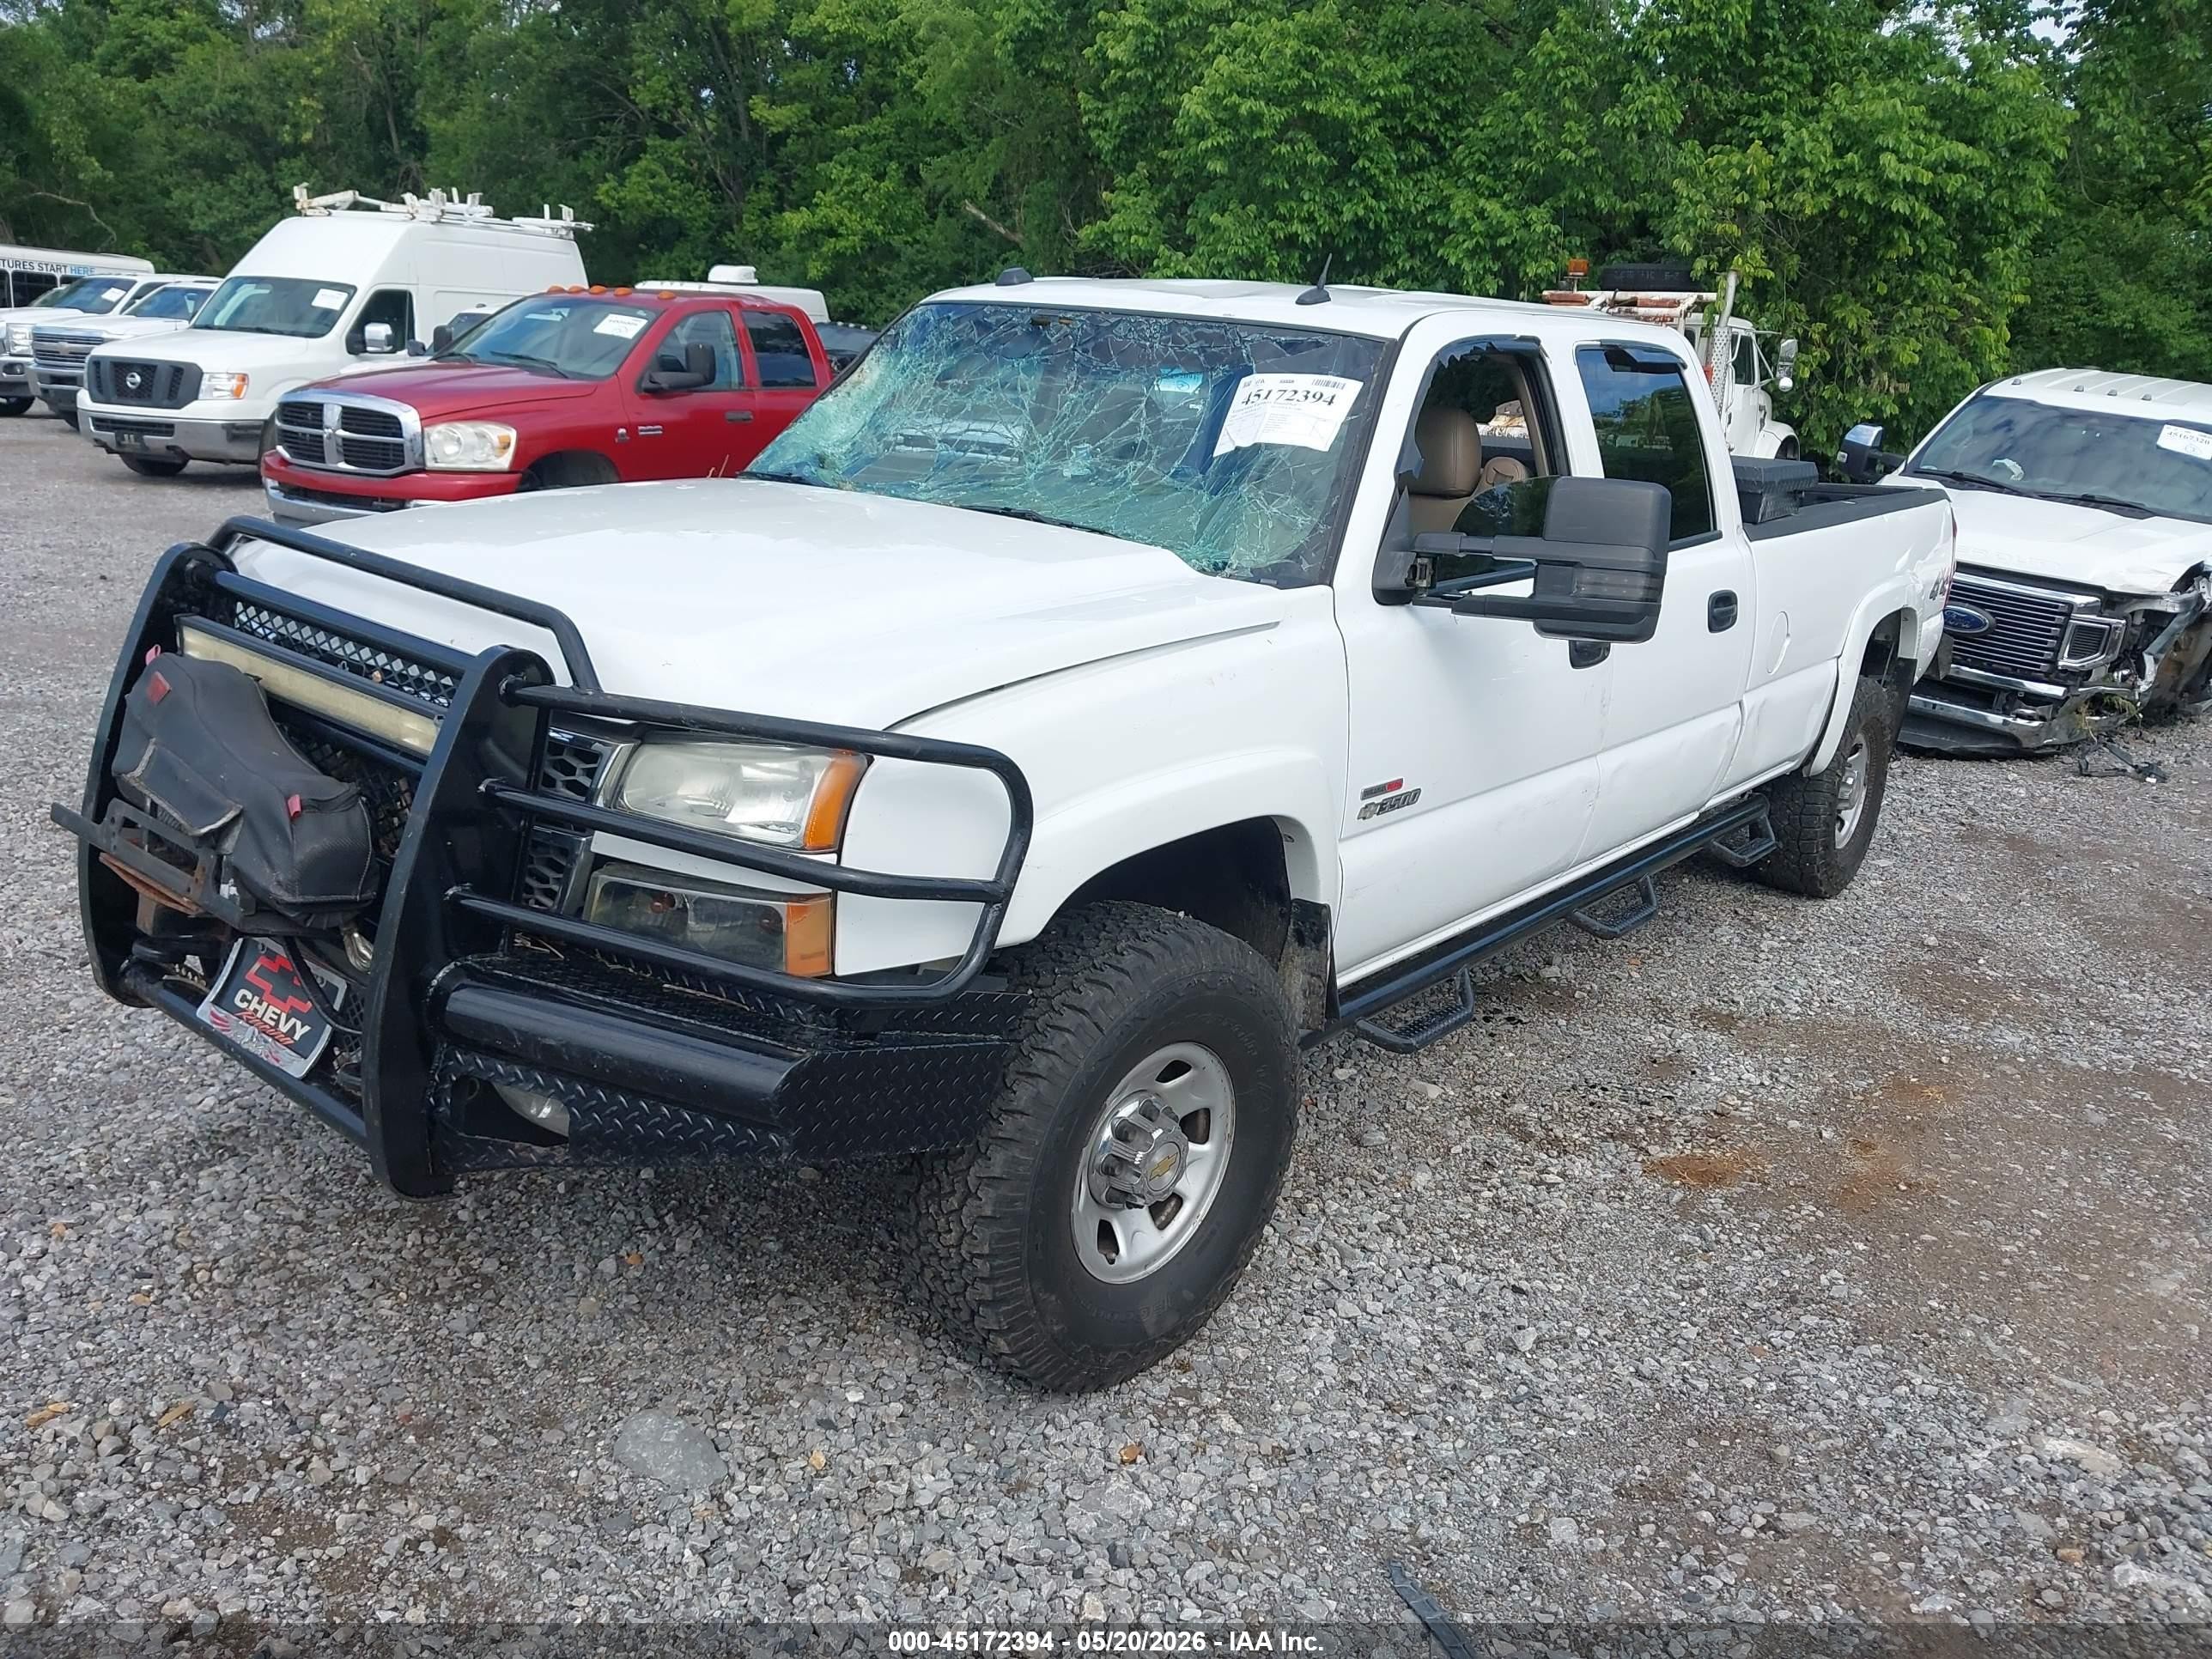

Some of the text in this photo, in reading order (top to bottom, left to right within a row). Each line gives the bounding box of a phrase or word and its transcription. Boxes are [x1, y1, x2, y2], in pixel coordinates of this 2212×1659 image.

[0, 258, 35, 270] TURES
[37, 262, 68, 274] START
[1241, 388, 1336, 406] 45172394
[1944, 610, 1972, 629] Ford
[1378, 788, 1421, 815] 3500
[234, 988, 312, 1042] CHEVY
